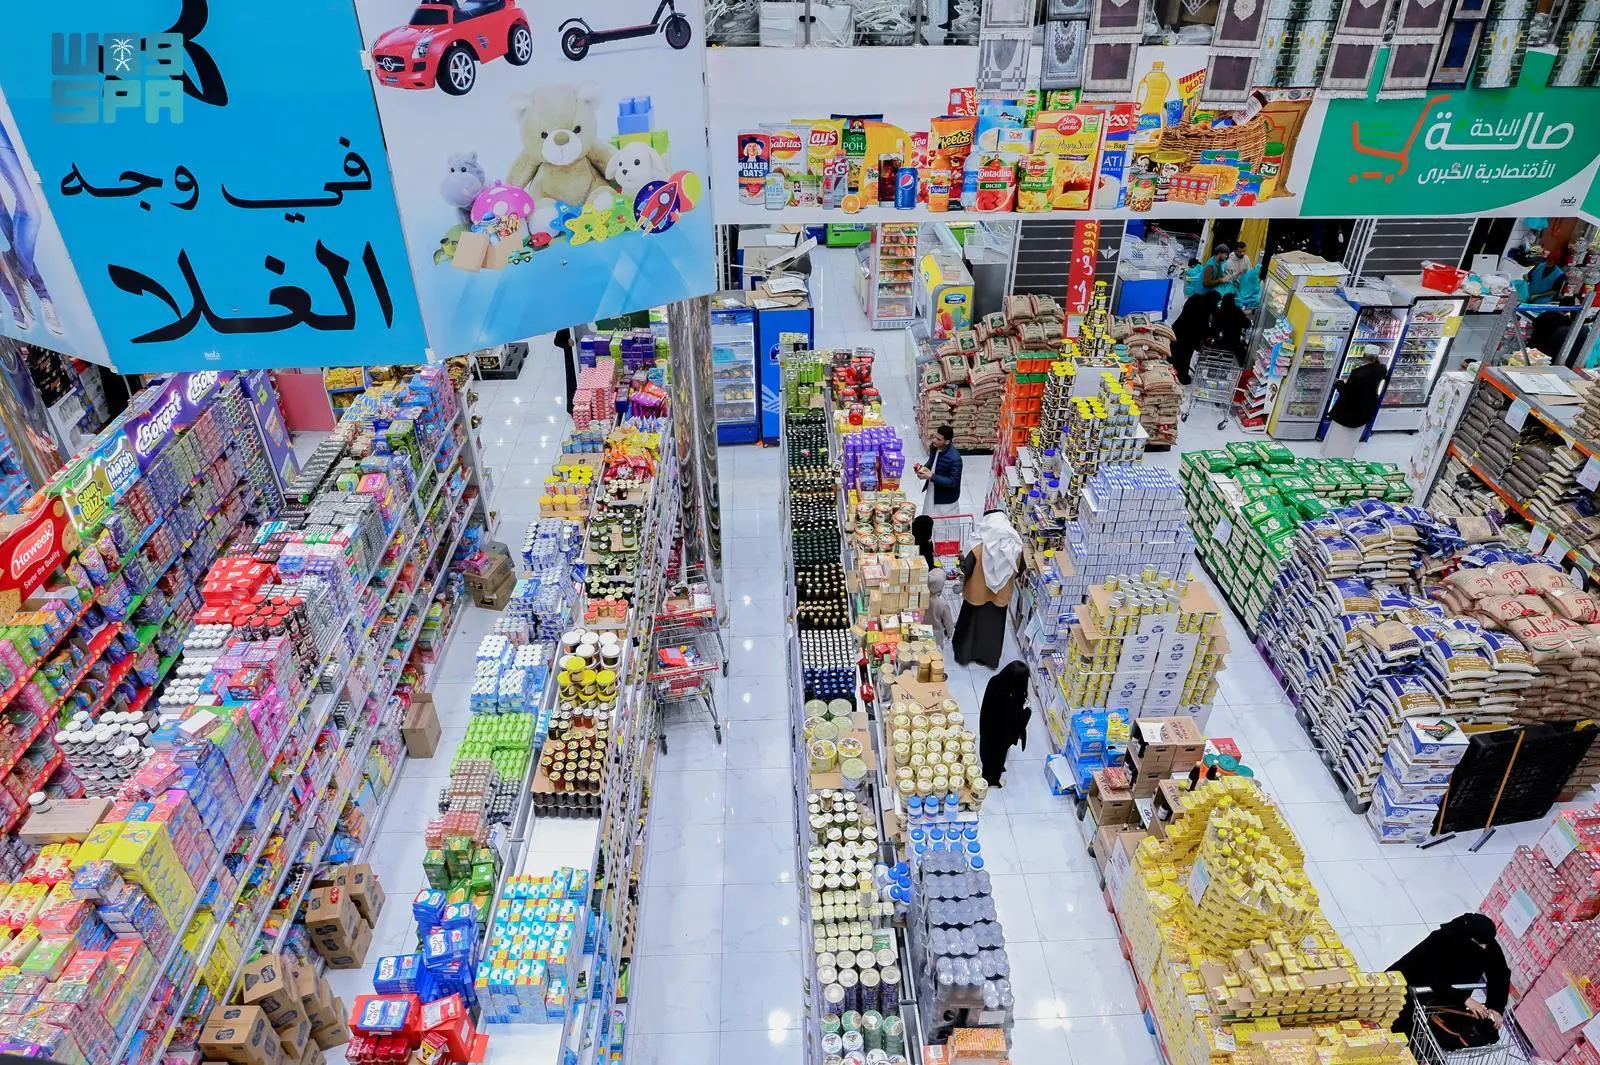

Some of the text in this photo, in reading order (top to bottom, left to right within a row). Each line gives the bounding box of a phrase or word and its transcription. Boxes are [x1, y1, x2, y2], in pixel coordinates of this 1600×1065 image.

[1425, 111, 1575, 150] صالة الباحة
[843, 142, 866, 151] POH
[59, 135, 373, 224] في وجه
[738, 162, 768, 172] QUAKER
[978, 168, 1012, 180] Contadina
[1418, 163, 1473, 185] الكبرى
[107, 238, 394, 345] الغلا
[107, 450, 134, 481] Marsh
[77, 482, 98, 503] SOUR
[14, 528, 54, 571] Haweek
[23, 549, 61, 590] Savor the Quality
